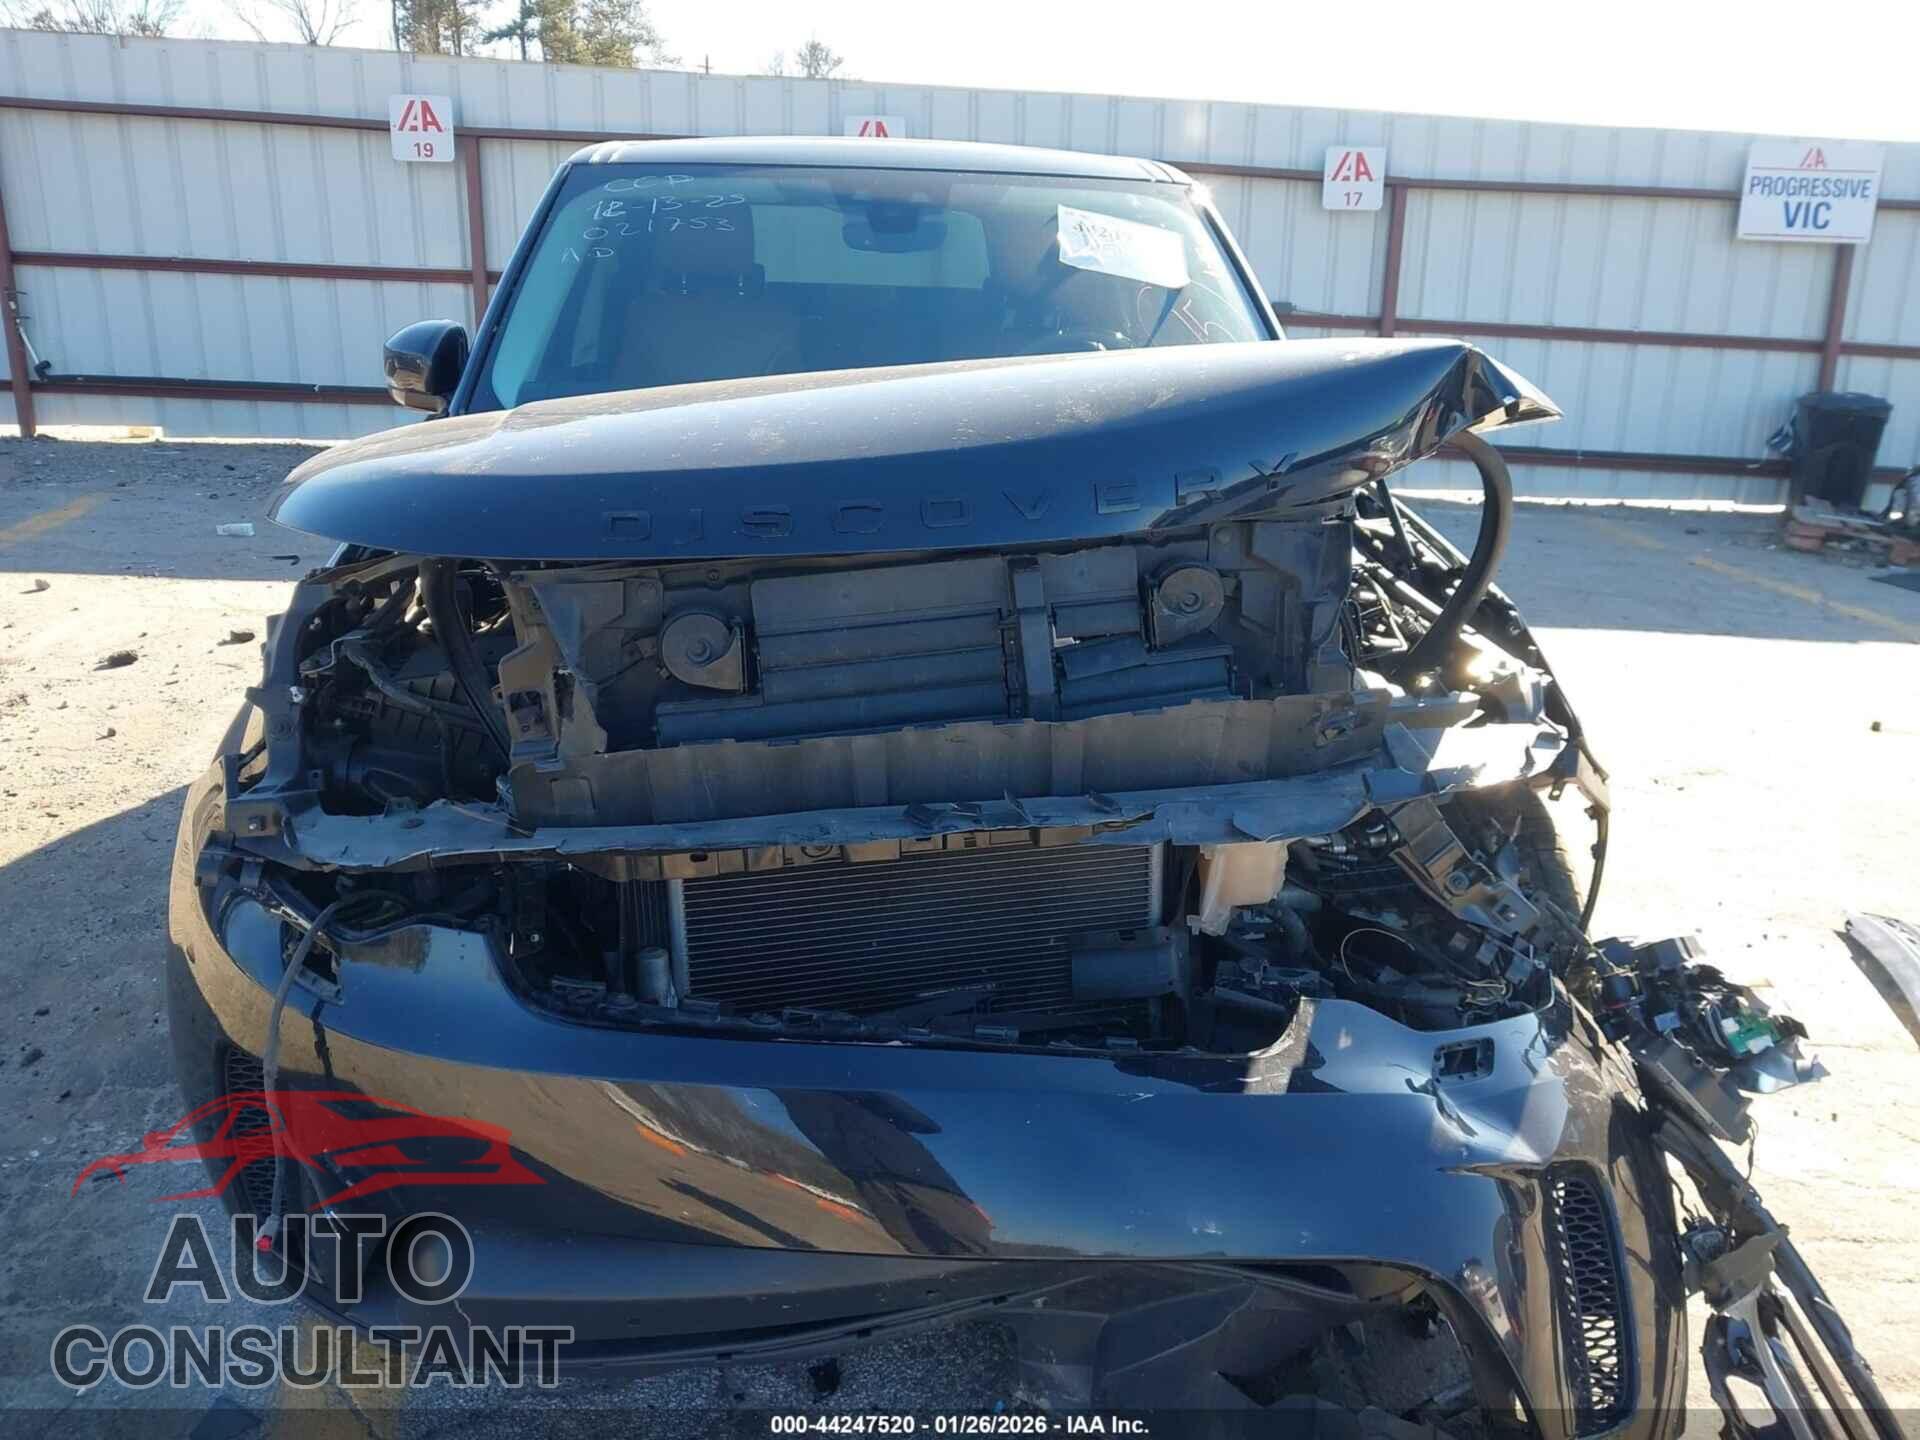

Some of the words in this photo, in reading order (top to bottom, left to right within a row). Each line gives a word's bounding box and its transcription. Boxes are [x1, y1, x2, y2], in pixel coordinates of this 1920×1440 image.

[413, 142, 434, 158] 19
[1343, 191, 1363, 207] 17
[1749, 175, 1873, 199] PROGRESSIVE
[1783, 201, 1832, 230] VIC
[605, 452, 1298, 544] DISCOVERY
